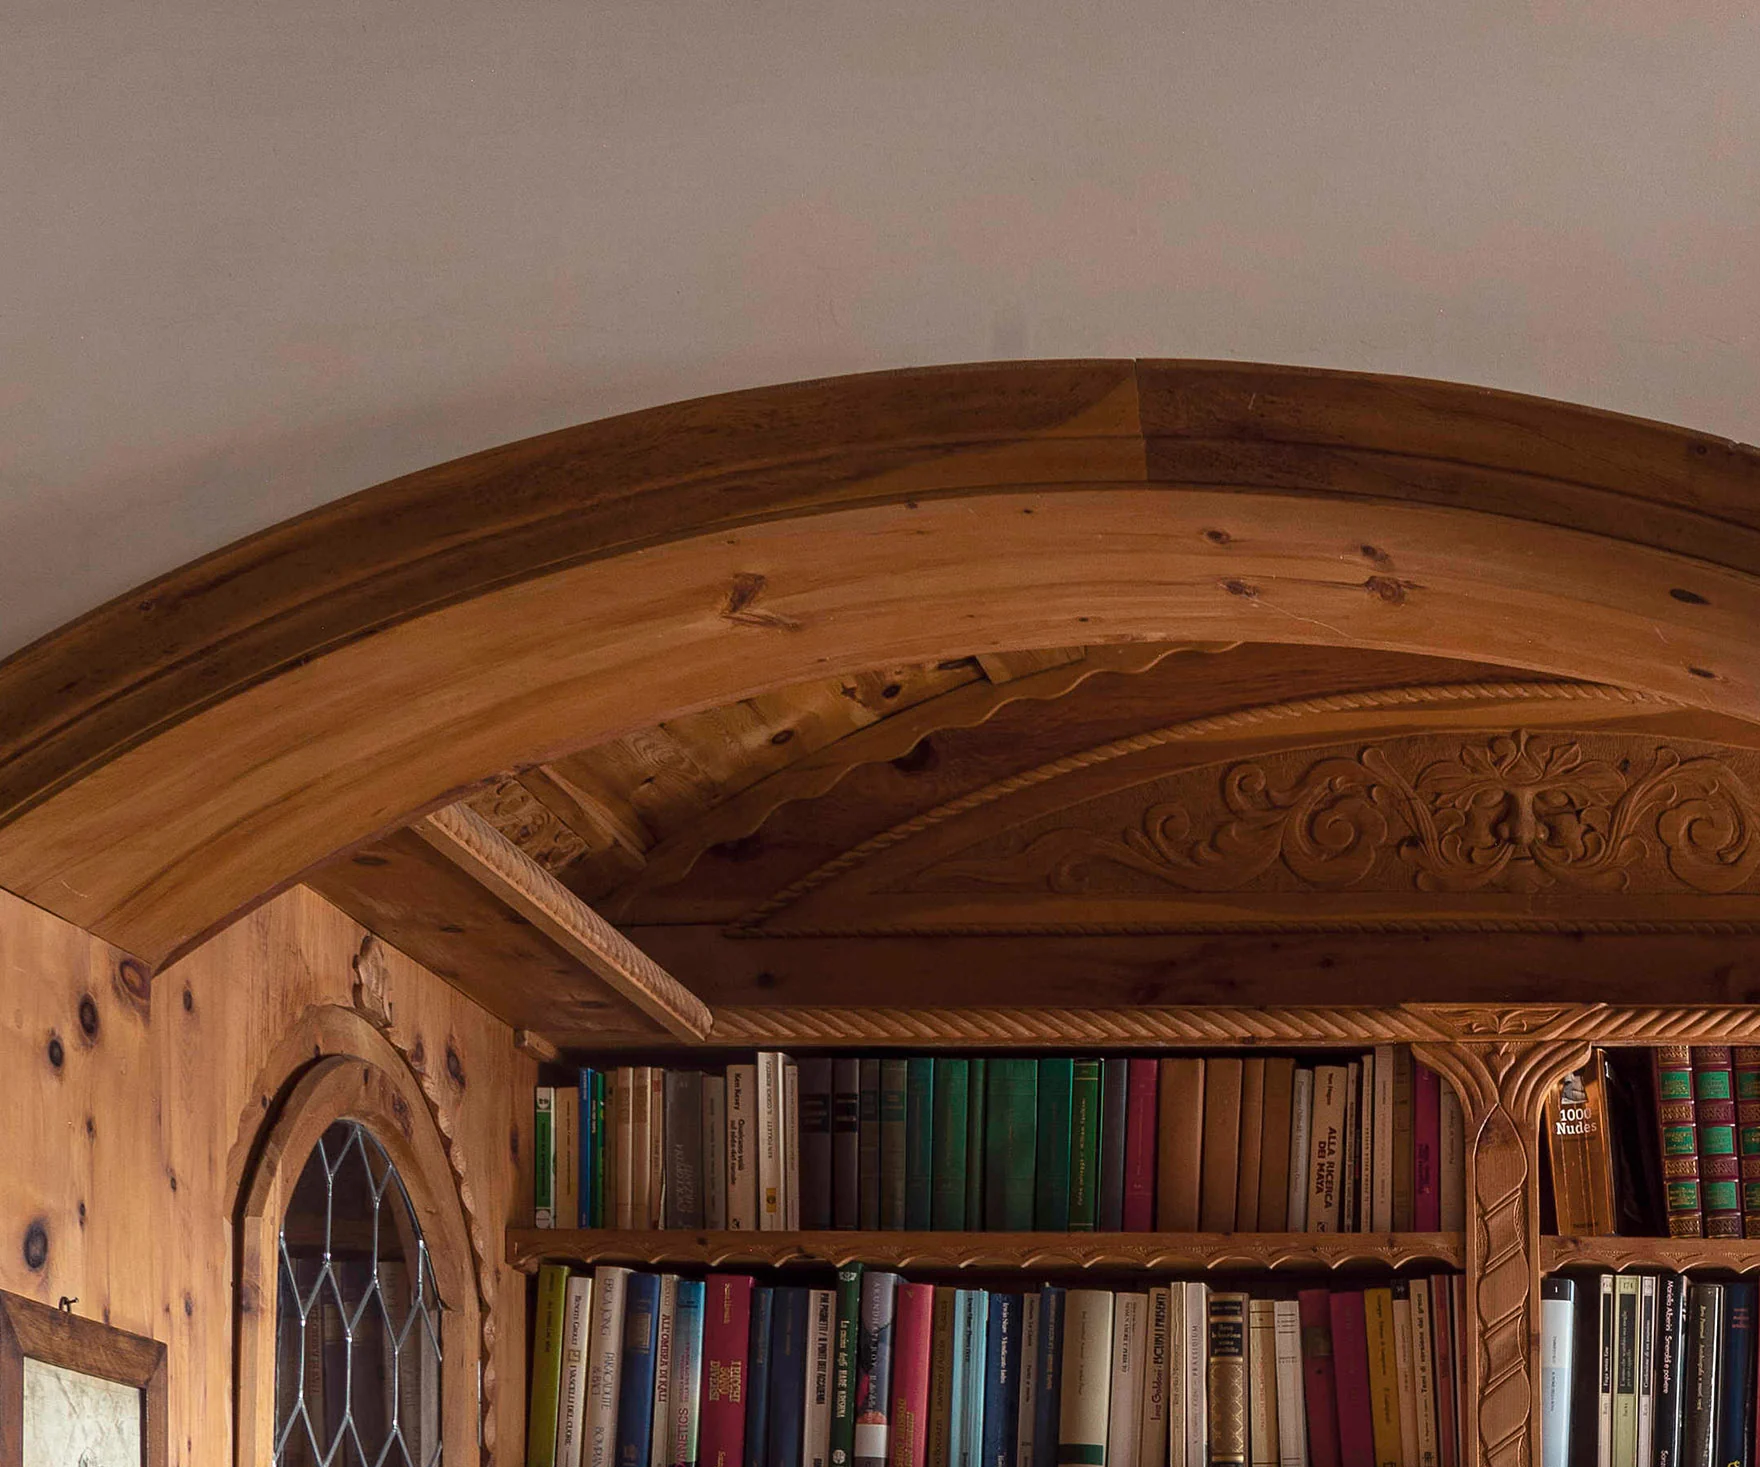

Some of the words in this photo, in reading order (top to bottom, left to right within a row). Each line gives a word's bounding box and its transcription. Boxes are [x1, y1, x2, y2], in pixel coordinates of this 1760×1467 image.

[1559, 1108, 1592, 1122] 1000
[1556, 1121, 1597, 1136] Nudes
[1317, 1141, 1326, 1159] DEI
[1327, 1127, 1337, 1156] ALLA
[1315, 1163, 1325, 1194] MAYA
[1324, 1161, 1335, 1209] RICERCA
[660, 1314, 672, 1367] ALL'OMBRA
[659, 1370, 669, 1379] DI
[657, 1380, 668, 1403] KALI
